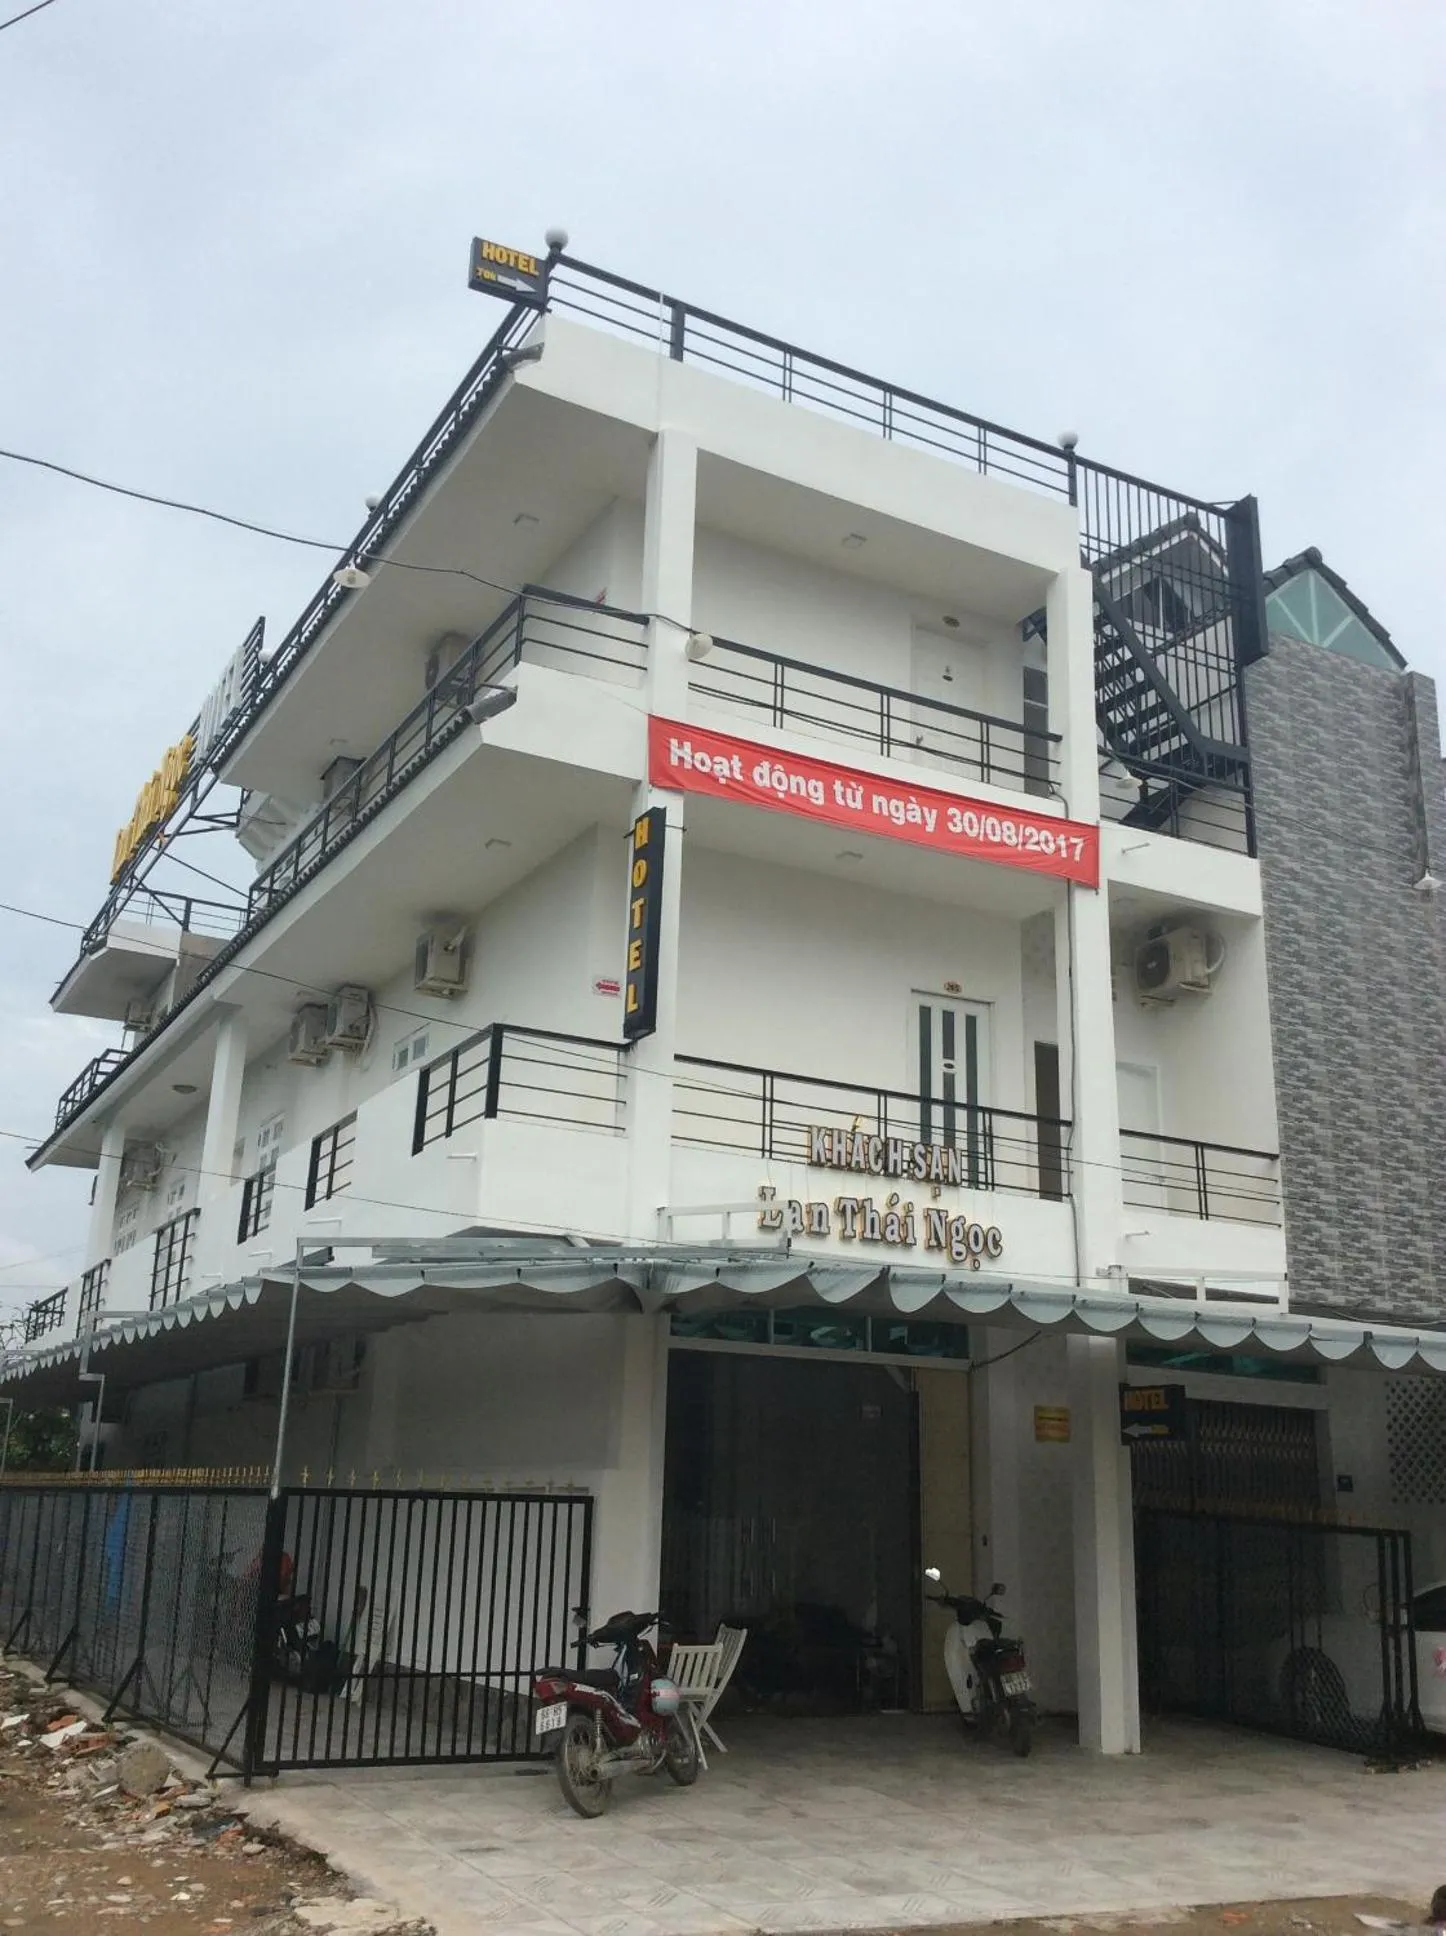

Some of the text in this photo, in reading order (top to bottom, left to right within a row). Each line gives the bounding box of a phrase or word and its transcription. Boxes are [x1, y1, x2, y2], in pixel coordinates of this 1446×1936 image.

[482, 240, 540, 277] HOTEL
[668, 737, 1086, 862] Hoạt động từ ngày 30/08/2017
[626, 815, 651, 1014] HOTEL
[808, 1115, 963, 1199] KHÁCH SẠN
[758, 1185, 1003, 1271] Lan Thái Ngọc
[1123, 1387, 1170, 1412] HOTEL
